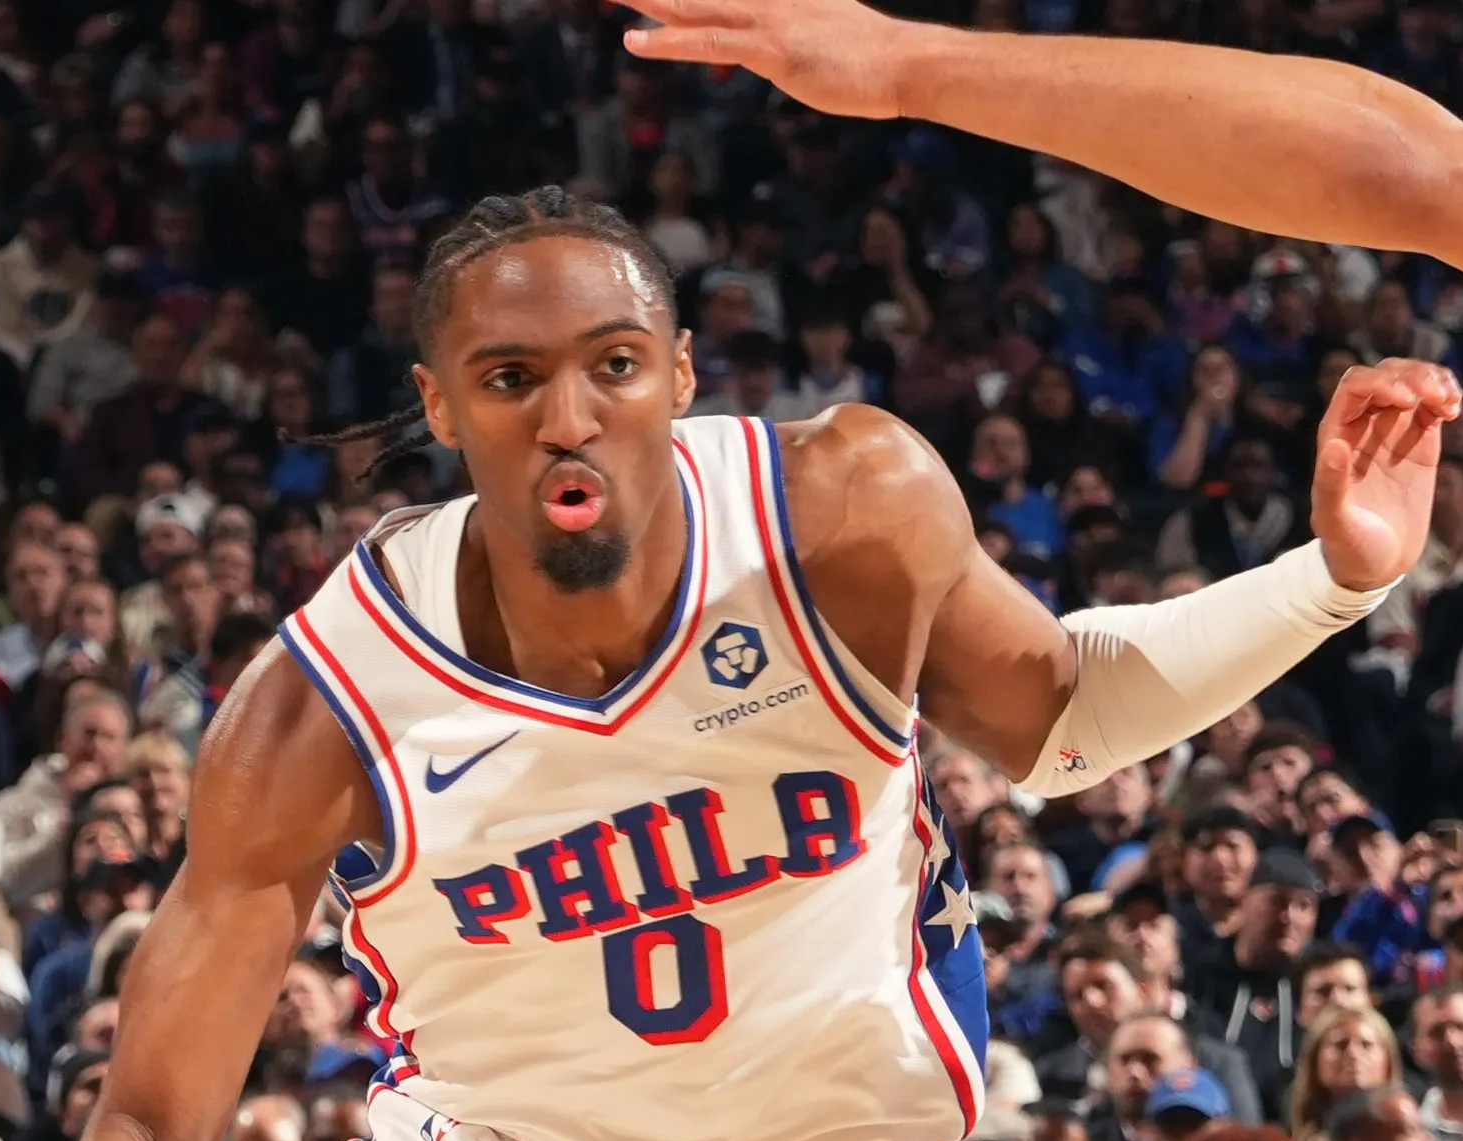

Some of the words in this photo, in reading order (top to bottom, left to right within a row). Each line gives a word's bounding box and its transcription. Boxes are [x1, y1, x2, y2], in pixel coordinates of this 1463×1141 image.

[694, 683, 810, 732] crypto.com
[432, 770, 867, 945] PHILA
[602, 913, 729, 1046] 0
